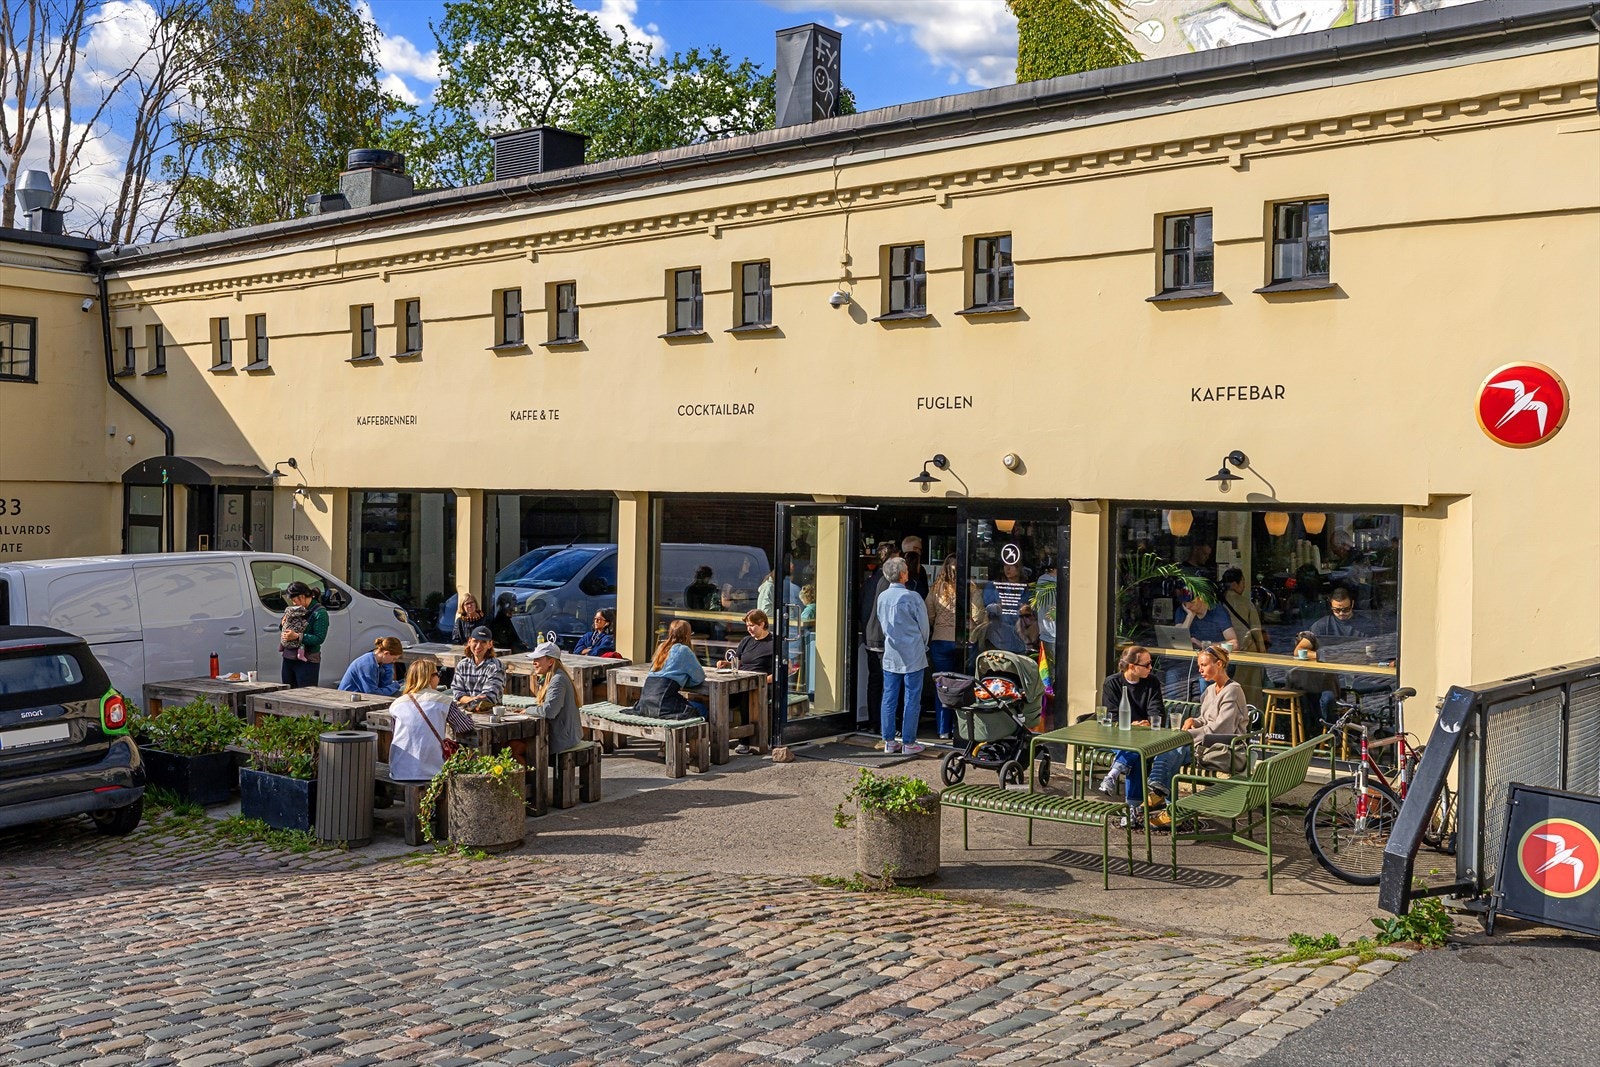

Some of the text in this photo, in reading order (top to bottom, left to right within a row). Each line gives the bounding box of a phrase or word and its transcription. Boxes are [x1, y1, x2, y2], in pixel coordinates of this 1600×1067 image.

[1191, 385, 1285, 401] KAFFEBAR
[917, 395, 973, 410] FUGLEN
[510, 409, 560, 421] KAFFE & TE
[677, 403, 755, 416] COCKTAILBAR
[356, 415, 418, 426] KAFFEBRENNERI
[20, 709, 44, 719] smart
